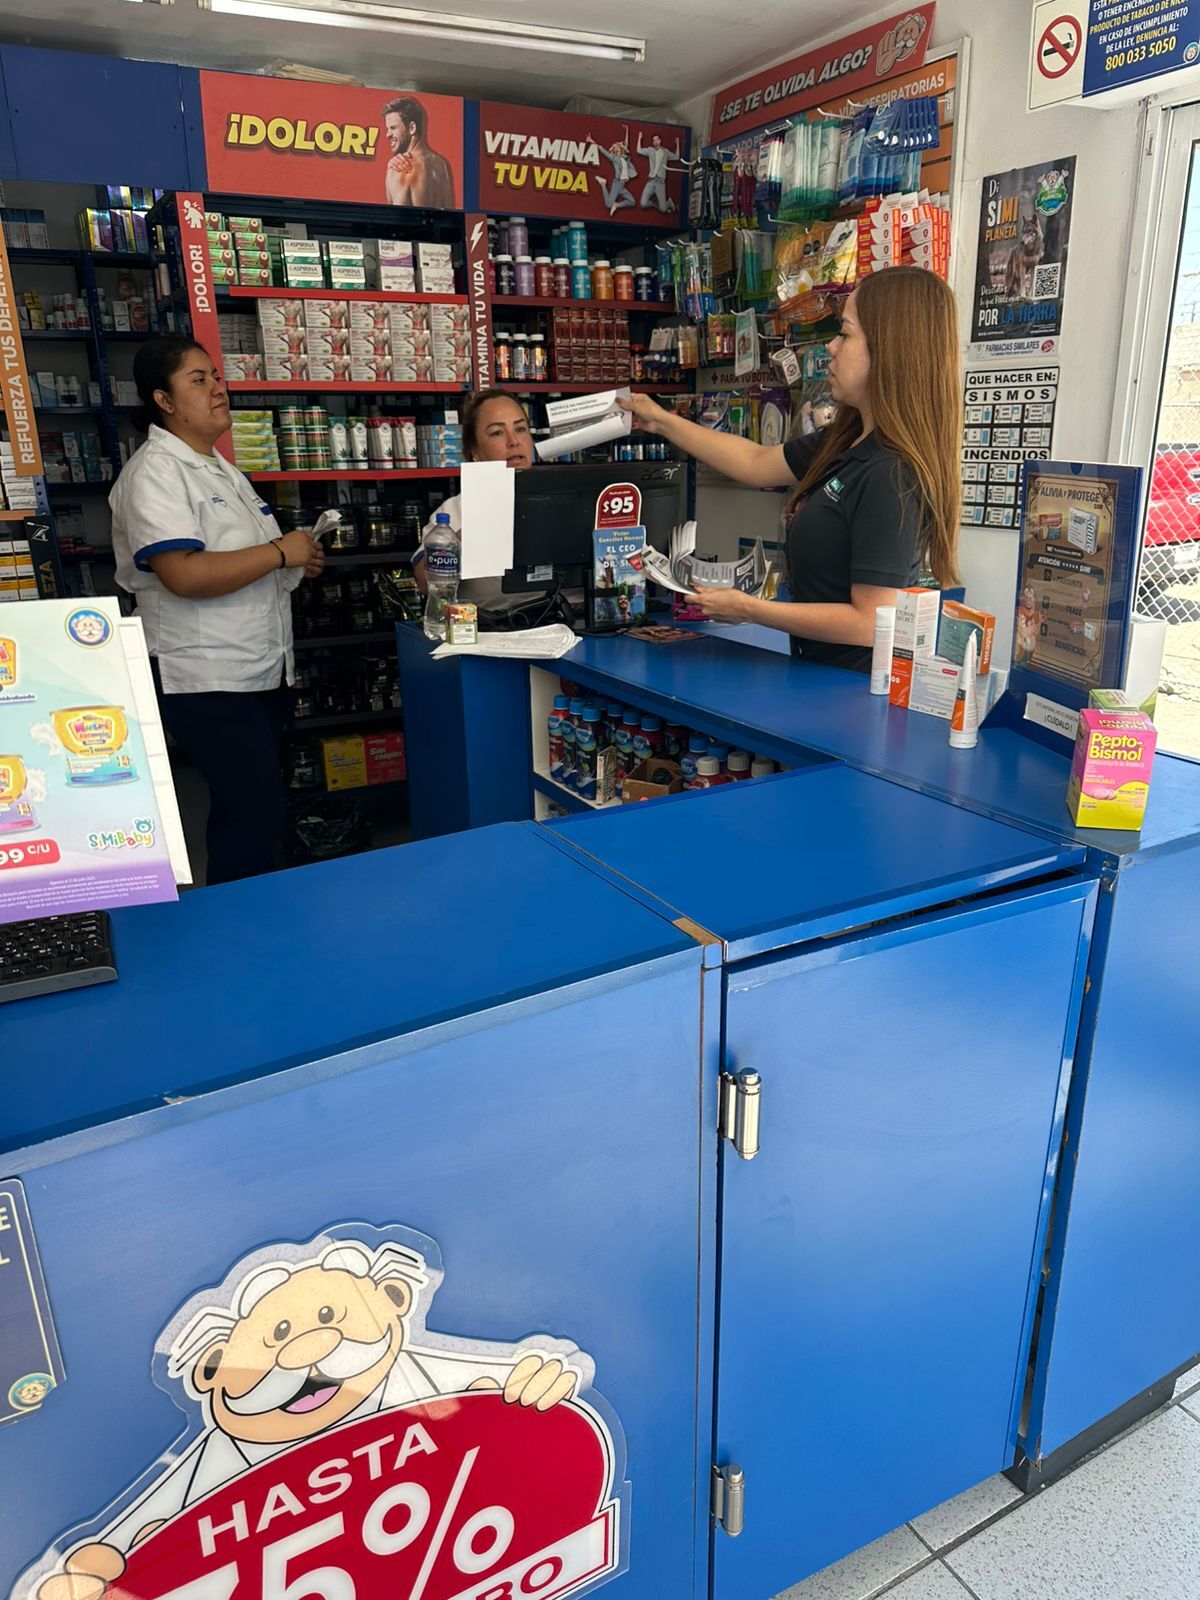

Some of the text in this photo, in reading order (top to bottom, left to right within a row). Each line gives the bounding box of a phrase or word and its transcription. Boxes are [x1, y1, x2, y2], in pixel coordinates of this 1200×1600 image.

[1089, 17, 1121, 35] PRODUCTO
[1121, 14, 1130, 24] DE
[1131, 6, 1154, 21] TABACO
[1155, 3, 1160, 13] O
[1160, 0, 1169, 11] DE
[1099, 6, 1189, 45] EN CASO DE INCUMPLIMIENTO
[1103, 5, 1122, 19] TENER
[1105, 43, 1114, 54] DE
[1114, 41, 1122, 52] LA
[1135, 25, 1168, 45] DENUNCIA
[1168, 22, 1180, 33] AL:
[1105, 35, 1177, 71] 800 033 5050
[719, 44, 874, 124] ¿SE TE OLVIDA ALGO?
[227, 113, 380, 157] ¡DOLOR!
[484, 130, 601, 166] VITAMINA
[494, 162, 589, 194] TU VIDA
[989, 179, 1000, 198] Di
[985, 224, 1017, 242] PLANETA
[188, 244, 212, 314] ¡DOLOR!
[472, 259, 491, 392] ITAMINA TU VIDA
[978, 302, 1057, 327] POR LA TIERRA
[3, 335, 19, 371] TUS
[986, 343, 1013, 353] FARMACIAS
[1013, 341, 1040, 351] SIMILARES
[968, 371, 1057, 386] QUE HACER EN:
[8, 374, 36, 464] REFUERZA
[963, 450, 1049, 461] INCENDIOS
[641, 463, 681, 481] acer
[602, 495, 635, 515] $95
[1040, 486, 1063, 497] ALIVIA
[1067, 489, 1100, 503] PROTEGE
[606, 544, 636, 553] EL CEO
[1088, 745, 1143, 761] Bismol
[1090, 732, 1143, 750] Pepto-
[198, 1423, 440, 1558] HASTA
